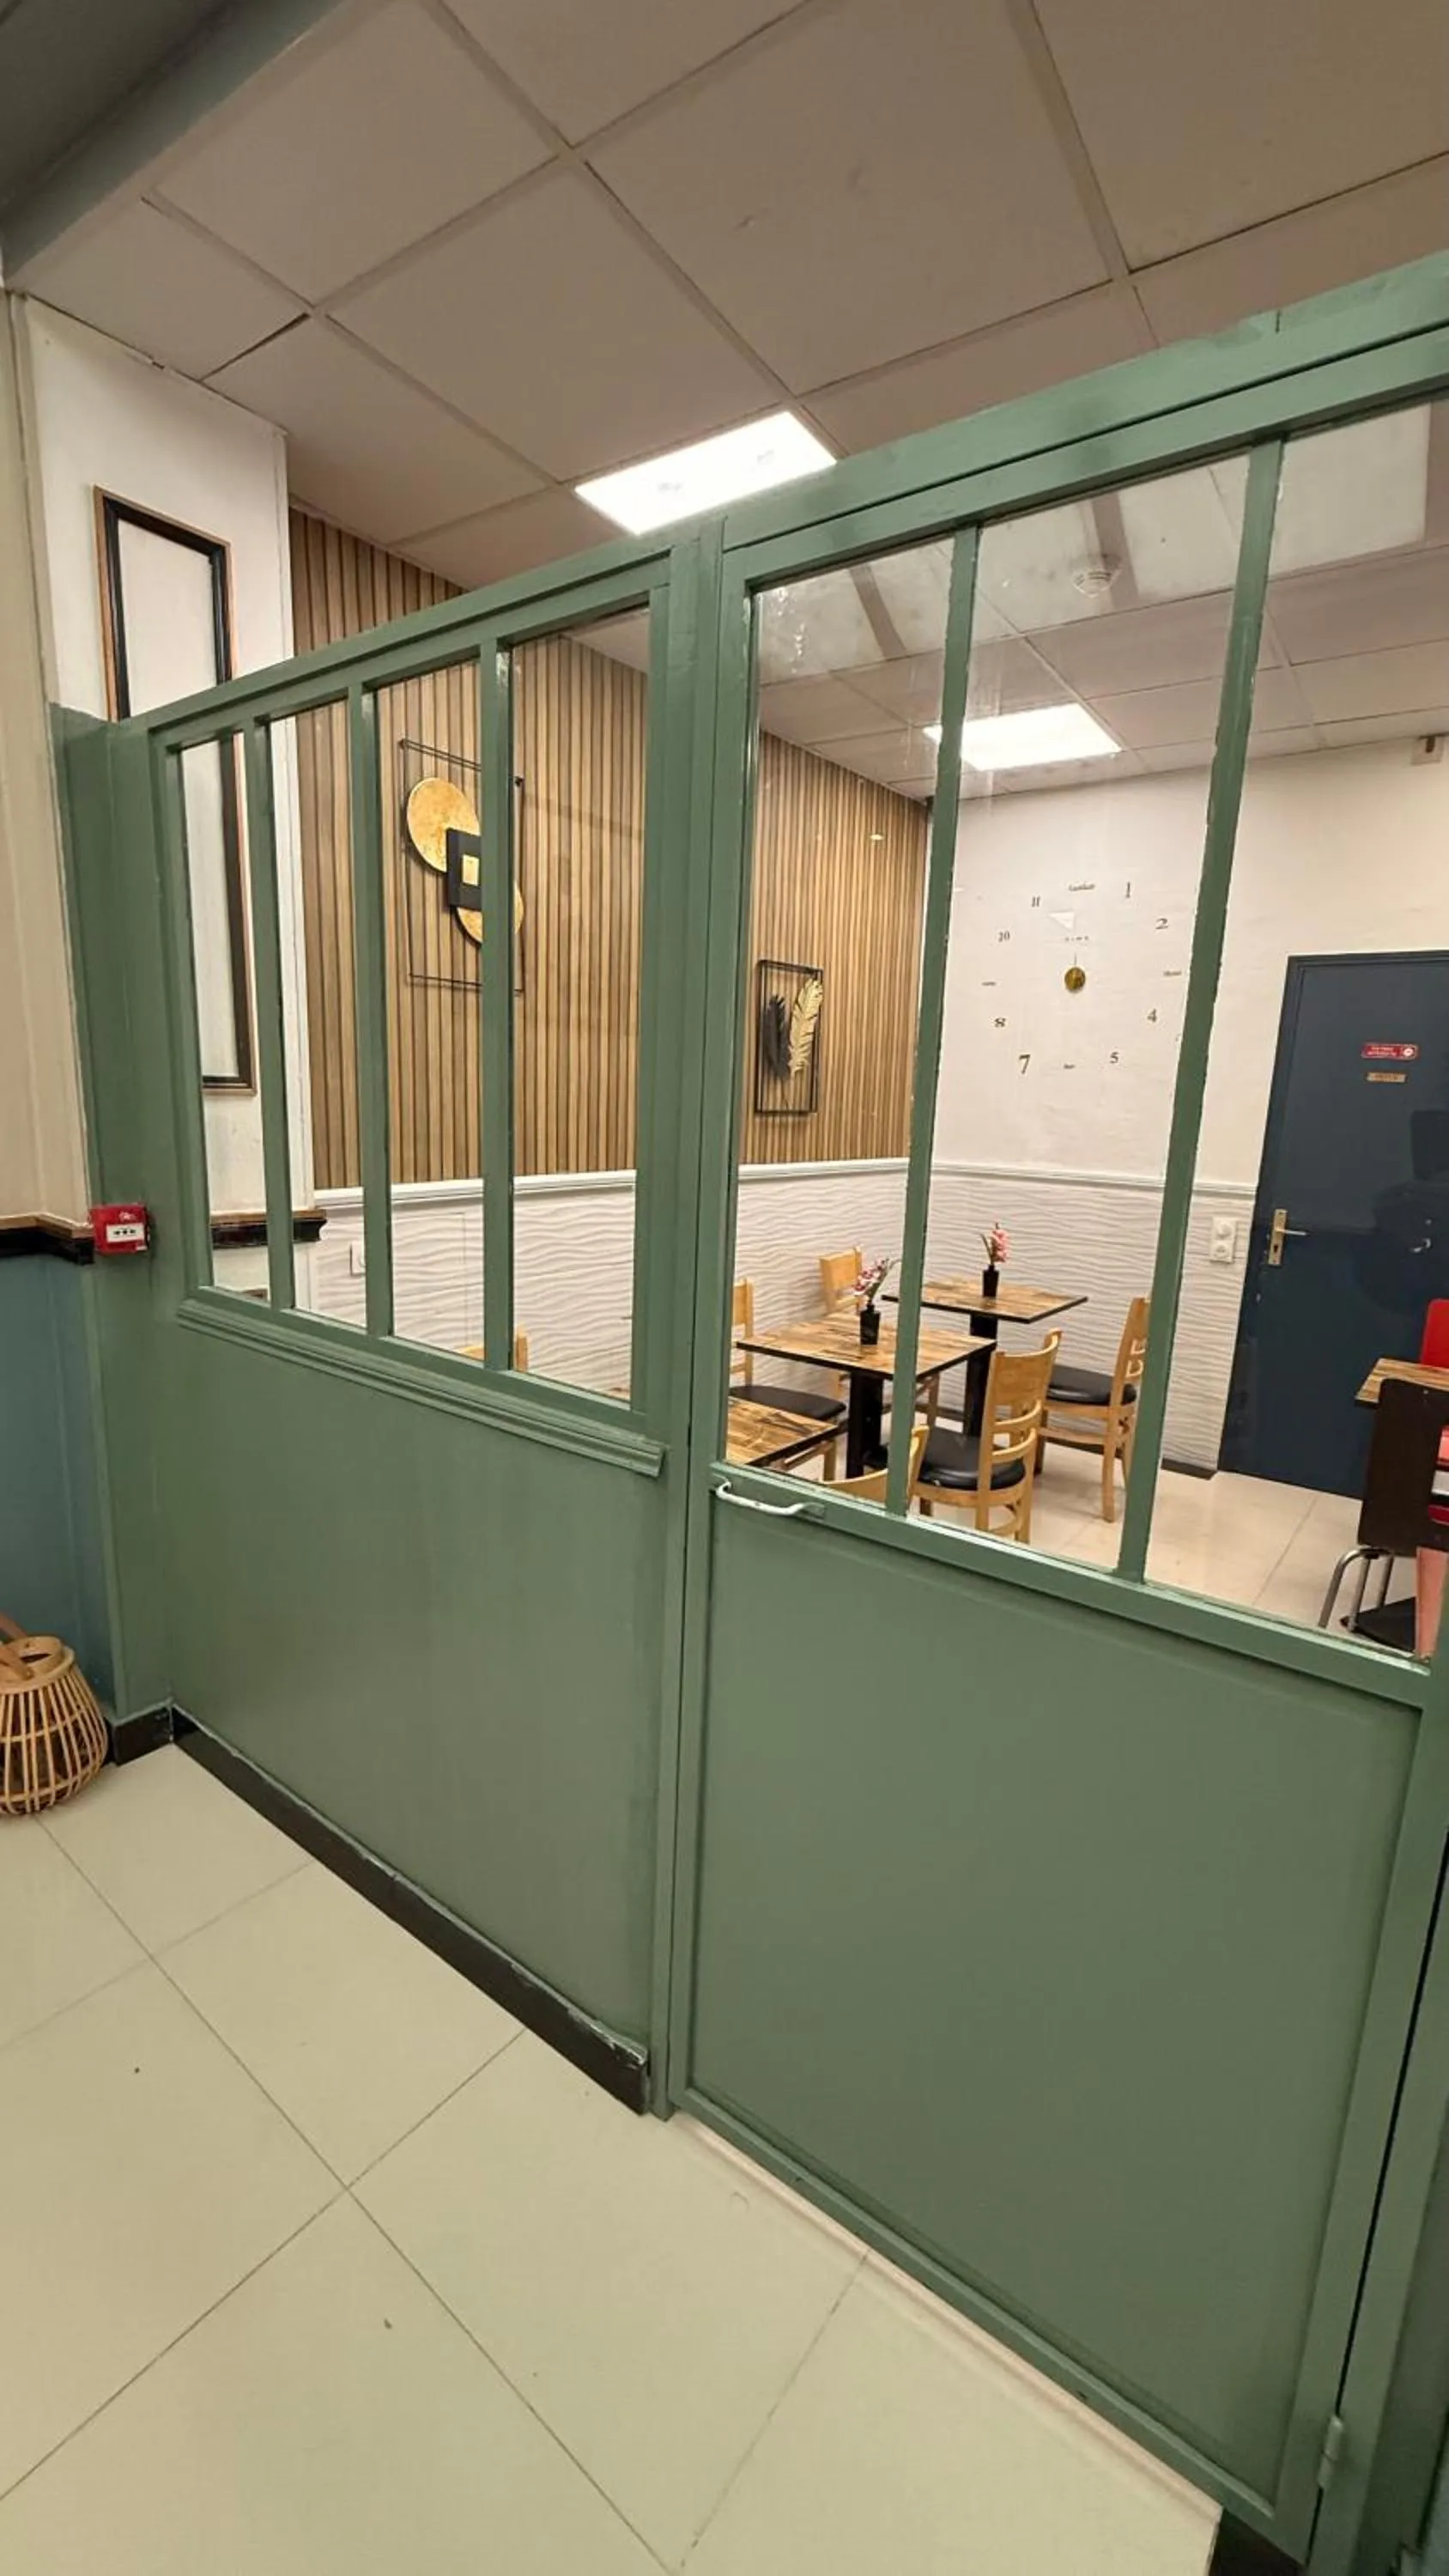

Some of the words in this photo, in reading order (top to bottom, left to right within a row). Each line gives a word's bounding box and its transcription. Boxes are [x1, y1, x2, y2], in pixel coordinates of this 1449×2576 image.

[1125, 881, 1131, 899] 1
[1155, 917, 1169, 930] 2
[1147, 1008, 1158, 1023] 4
[994, 1018, 1006, 1028] 8
[1018, 1054, 1031, 1074] 7
[1110, 1051, 1119, 1064] 5
